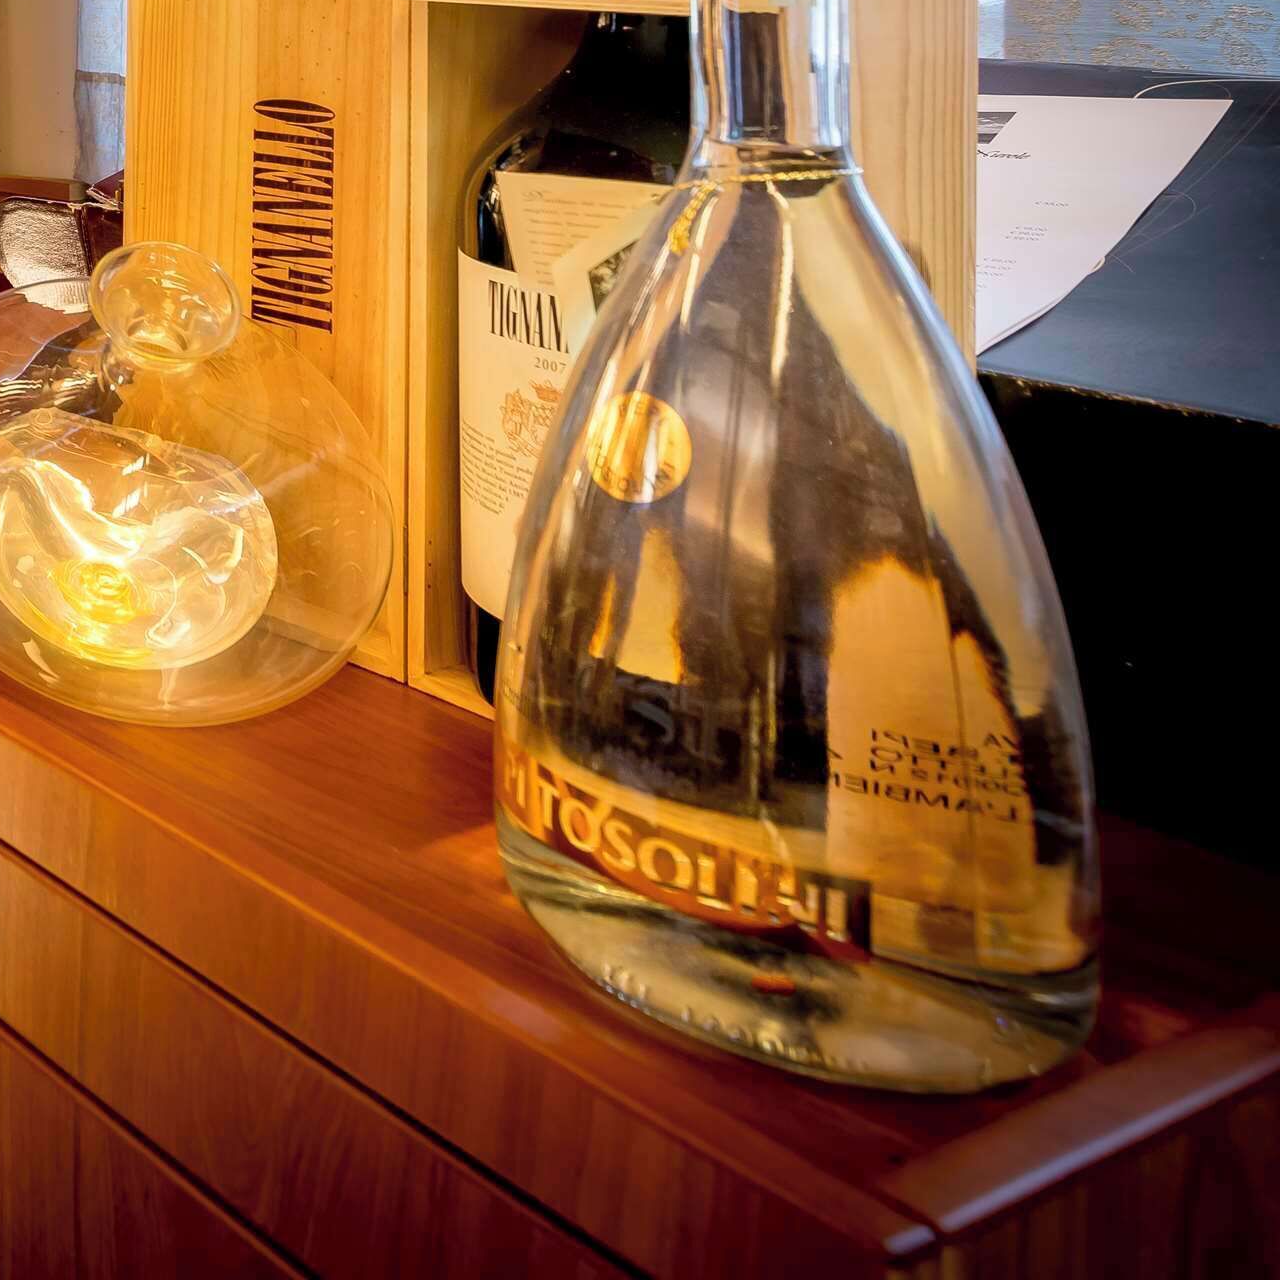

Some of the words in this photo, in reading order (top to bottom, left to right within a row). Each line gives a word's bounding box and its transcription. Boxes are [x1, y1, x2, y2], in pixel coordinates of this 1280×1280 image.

[251, 99, 336, 334] TIGNANELLO
[487, 279, 570, 355] TIGNAN
[533, 356, 566, 373] 2007
